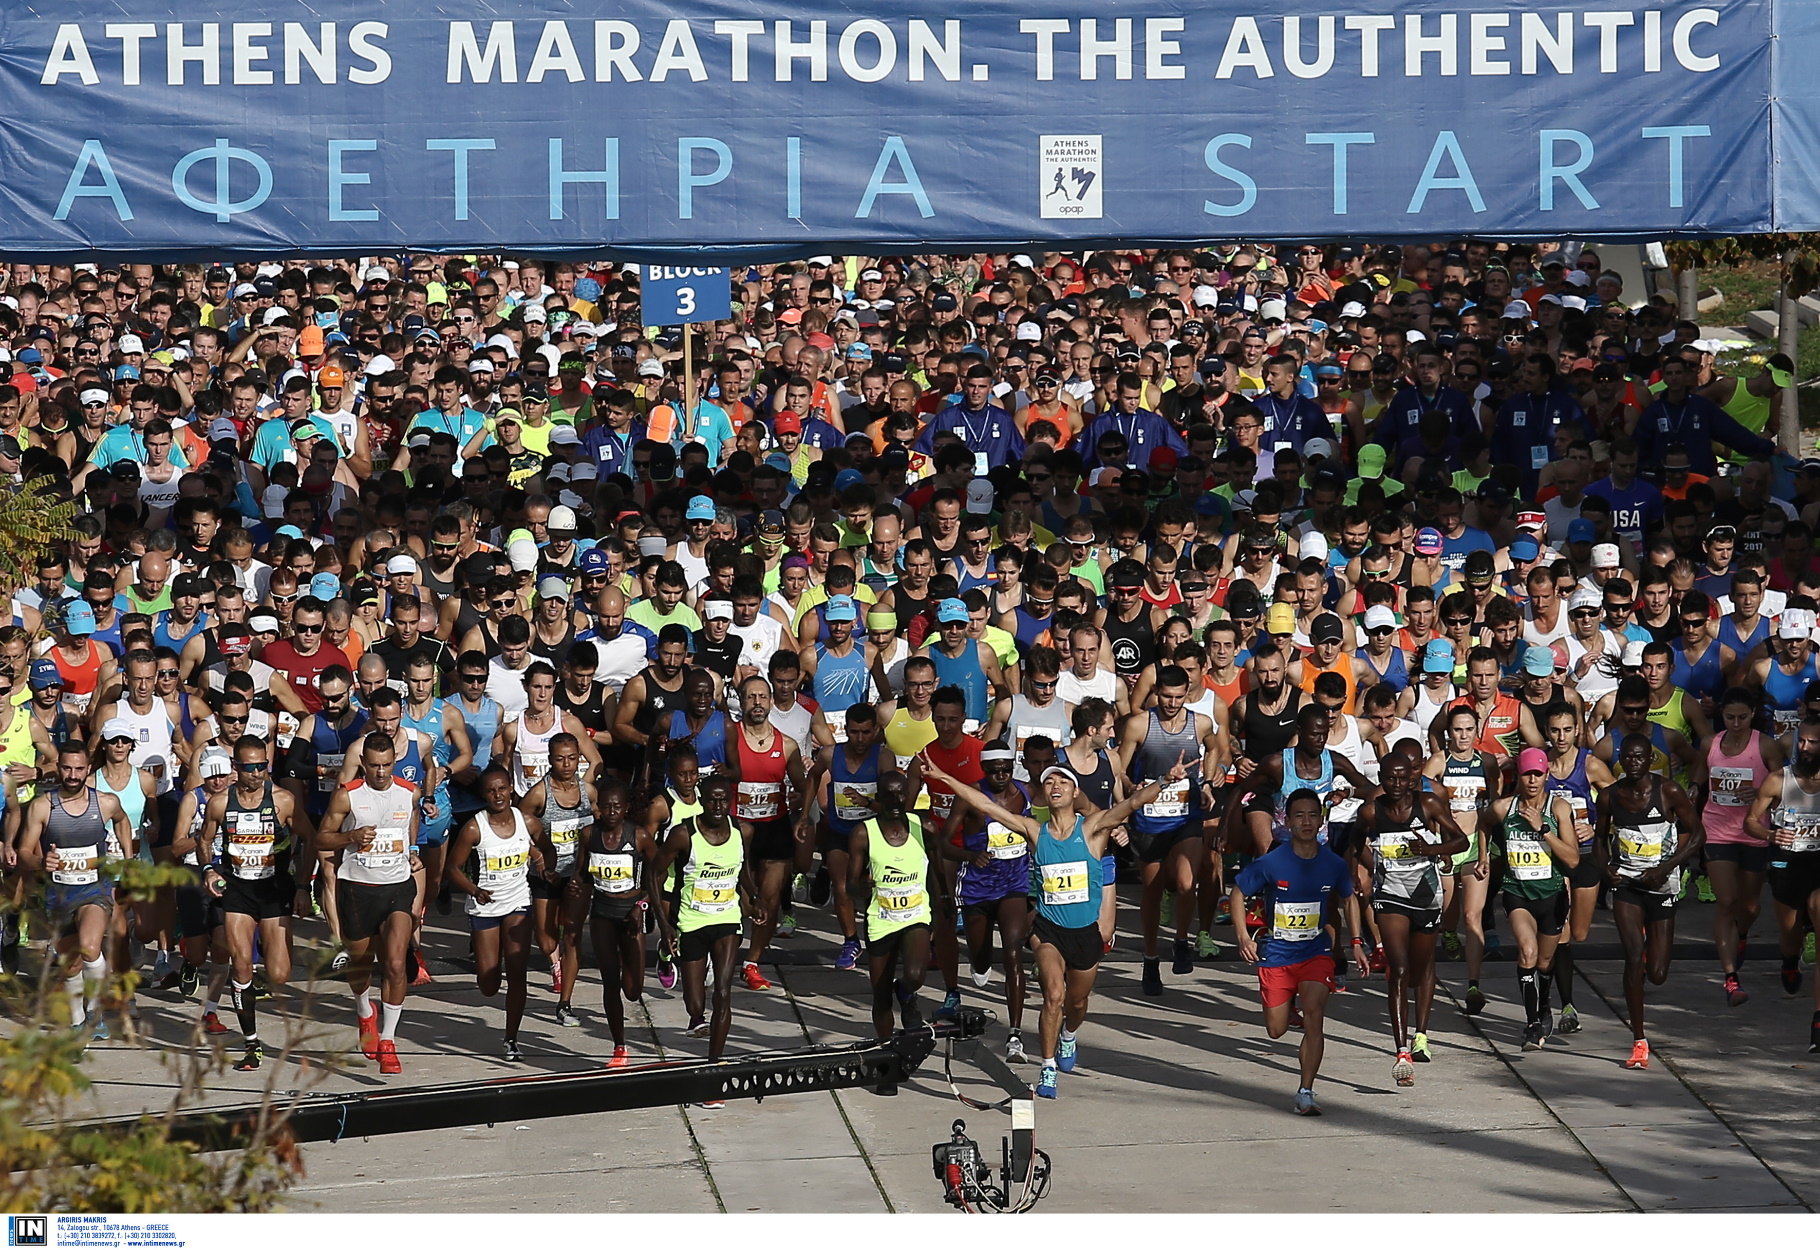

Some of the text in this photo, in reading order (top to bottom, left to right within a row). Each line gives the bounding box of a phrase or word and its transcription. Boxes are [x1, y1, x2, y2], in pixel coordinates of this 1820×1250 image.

[40, 8, 1721, 86] ATHENS MARATHON. THE AUTHENTIC
[1203, 125, 1712, 217] START
[52, 135, 936, 223] ΑΦΕΤΗΡΙΑ
[1059, 206, 1084, 215] opap
[676, 287, 696, 316] 3
[140, 493, 180, 502] LANCER
[1718, 780, 1742, 791] 407
[1156, 791, 1179, 803] 205
[1453, 786, 1478, 798] 403
[749, 794, 769, 805] 312
[1795, 825, 1818, 838] 224
[233, 835, 268, 844] DHL
[1007, 832, 1014, 844] 6
[370, 841, 393, 852] 203
[1400, 844, 1409, 856] 2
[1635, 842, 1642, 853] 7
[240, 856, 263, 867] 201
[498, 854, 521, 869] 102
[1515, 852, 1540, 865] 103
[62, 859, 87, 871] 270
[598, 867, 622, 878] 104
[700, 867, 736, 880] Rogelli
[882, 872, 919, 884] Rogelli
[1056, 876, 1072, 889] 21
[712, 889, 721, 901] 9
[893, 896, 909, 908] 10
[1287, 915, 1308, 927] 22
